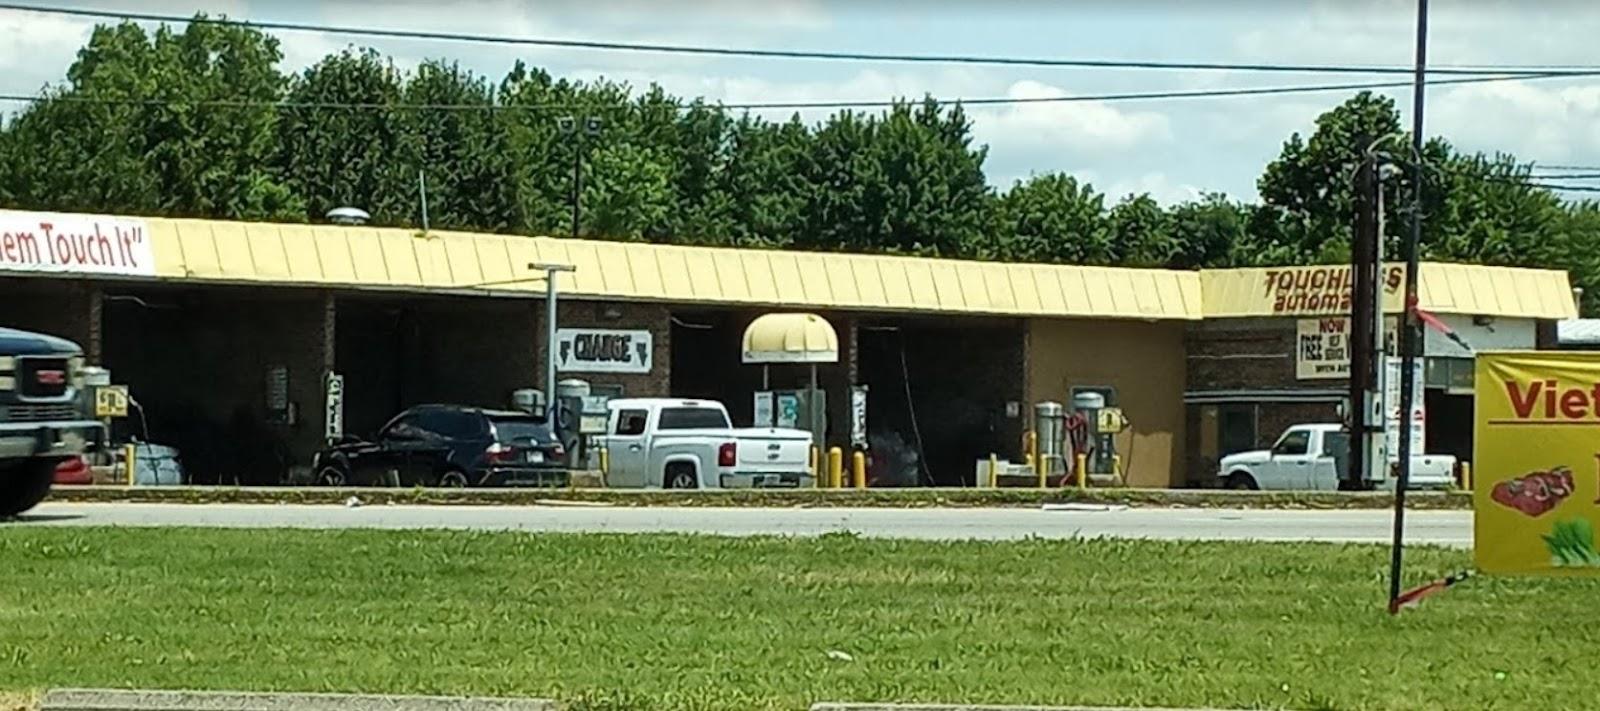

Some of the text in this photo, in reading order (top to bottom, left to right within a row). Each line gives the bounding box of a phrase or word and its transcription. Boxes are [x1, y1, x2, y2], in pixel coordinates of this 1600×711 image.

[0, 231, 41, 264] em
[40, 222, 115, 266] Touch
[1320, 318, 1346, 333] NOW
[574, 333, 632, 363] CHANGE
